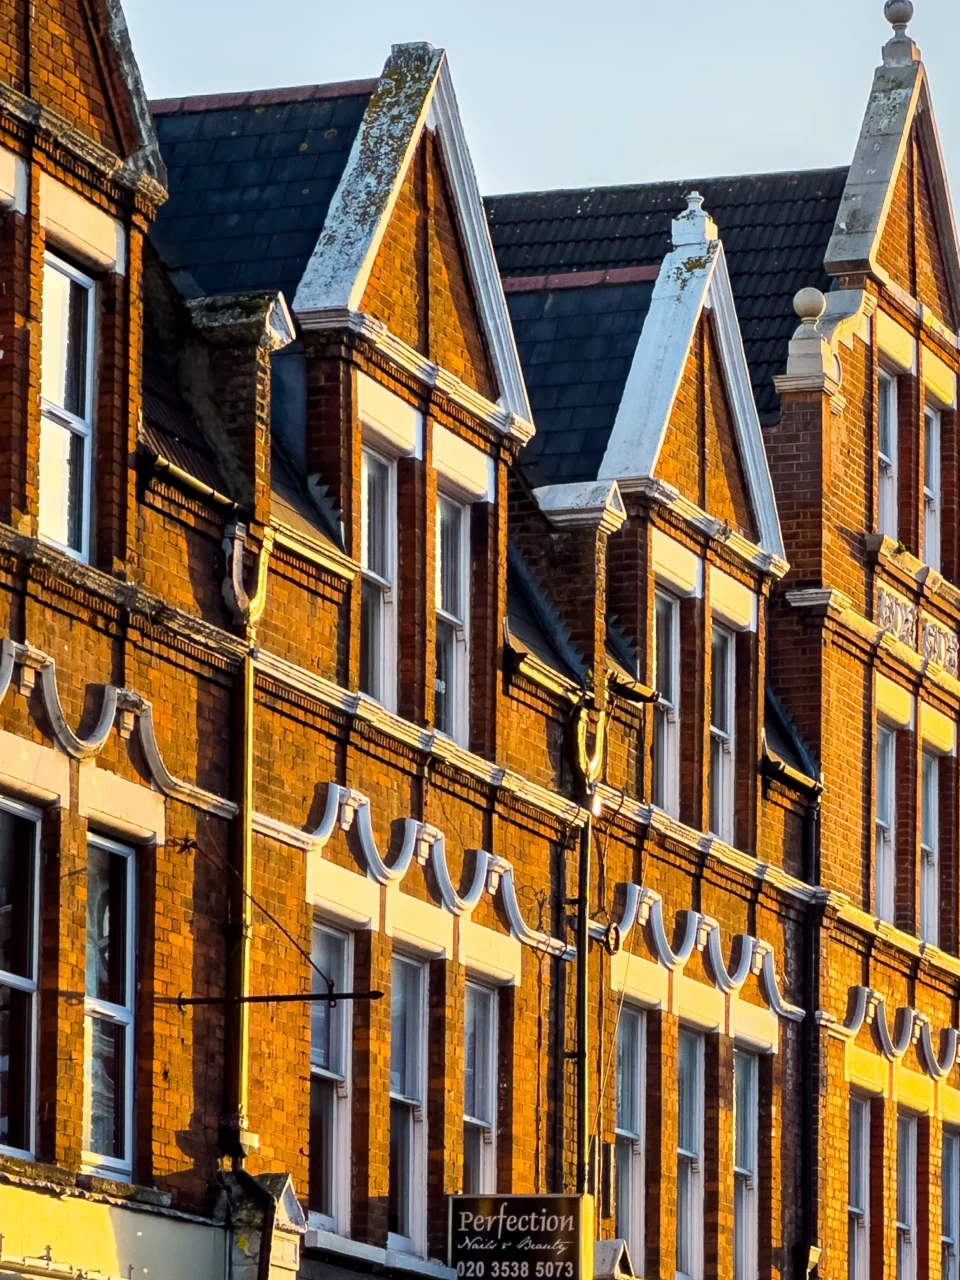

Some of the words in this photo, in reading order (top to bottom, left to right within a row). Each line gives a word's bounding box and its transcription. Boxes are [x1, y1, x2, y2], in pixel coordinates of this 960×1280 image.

[458, 1202, 575, 1239] Perfection
[458, 1236, 497, 1250] Nails
[516, 1236, 574, 1255] Beauty
[457, 1261, 485, 1278] 020
[491, 1261, 529, 1278] 3538
[535, 1261, 573, 1278] 5073
